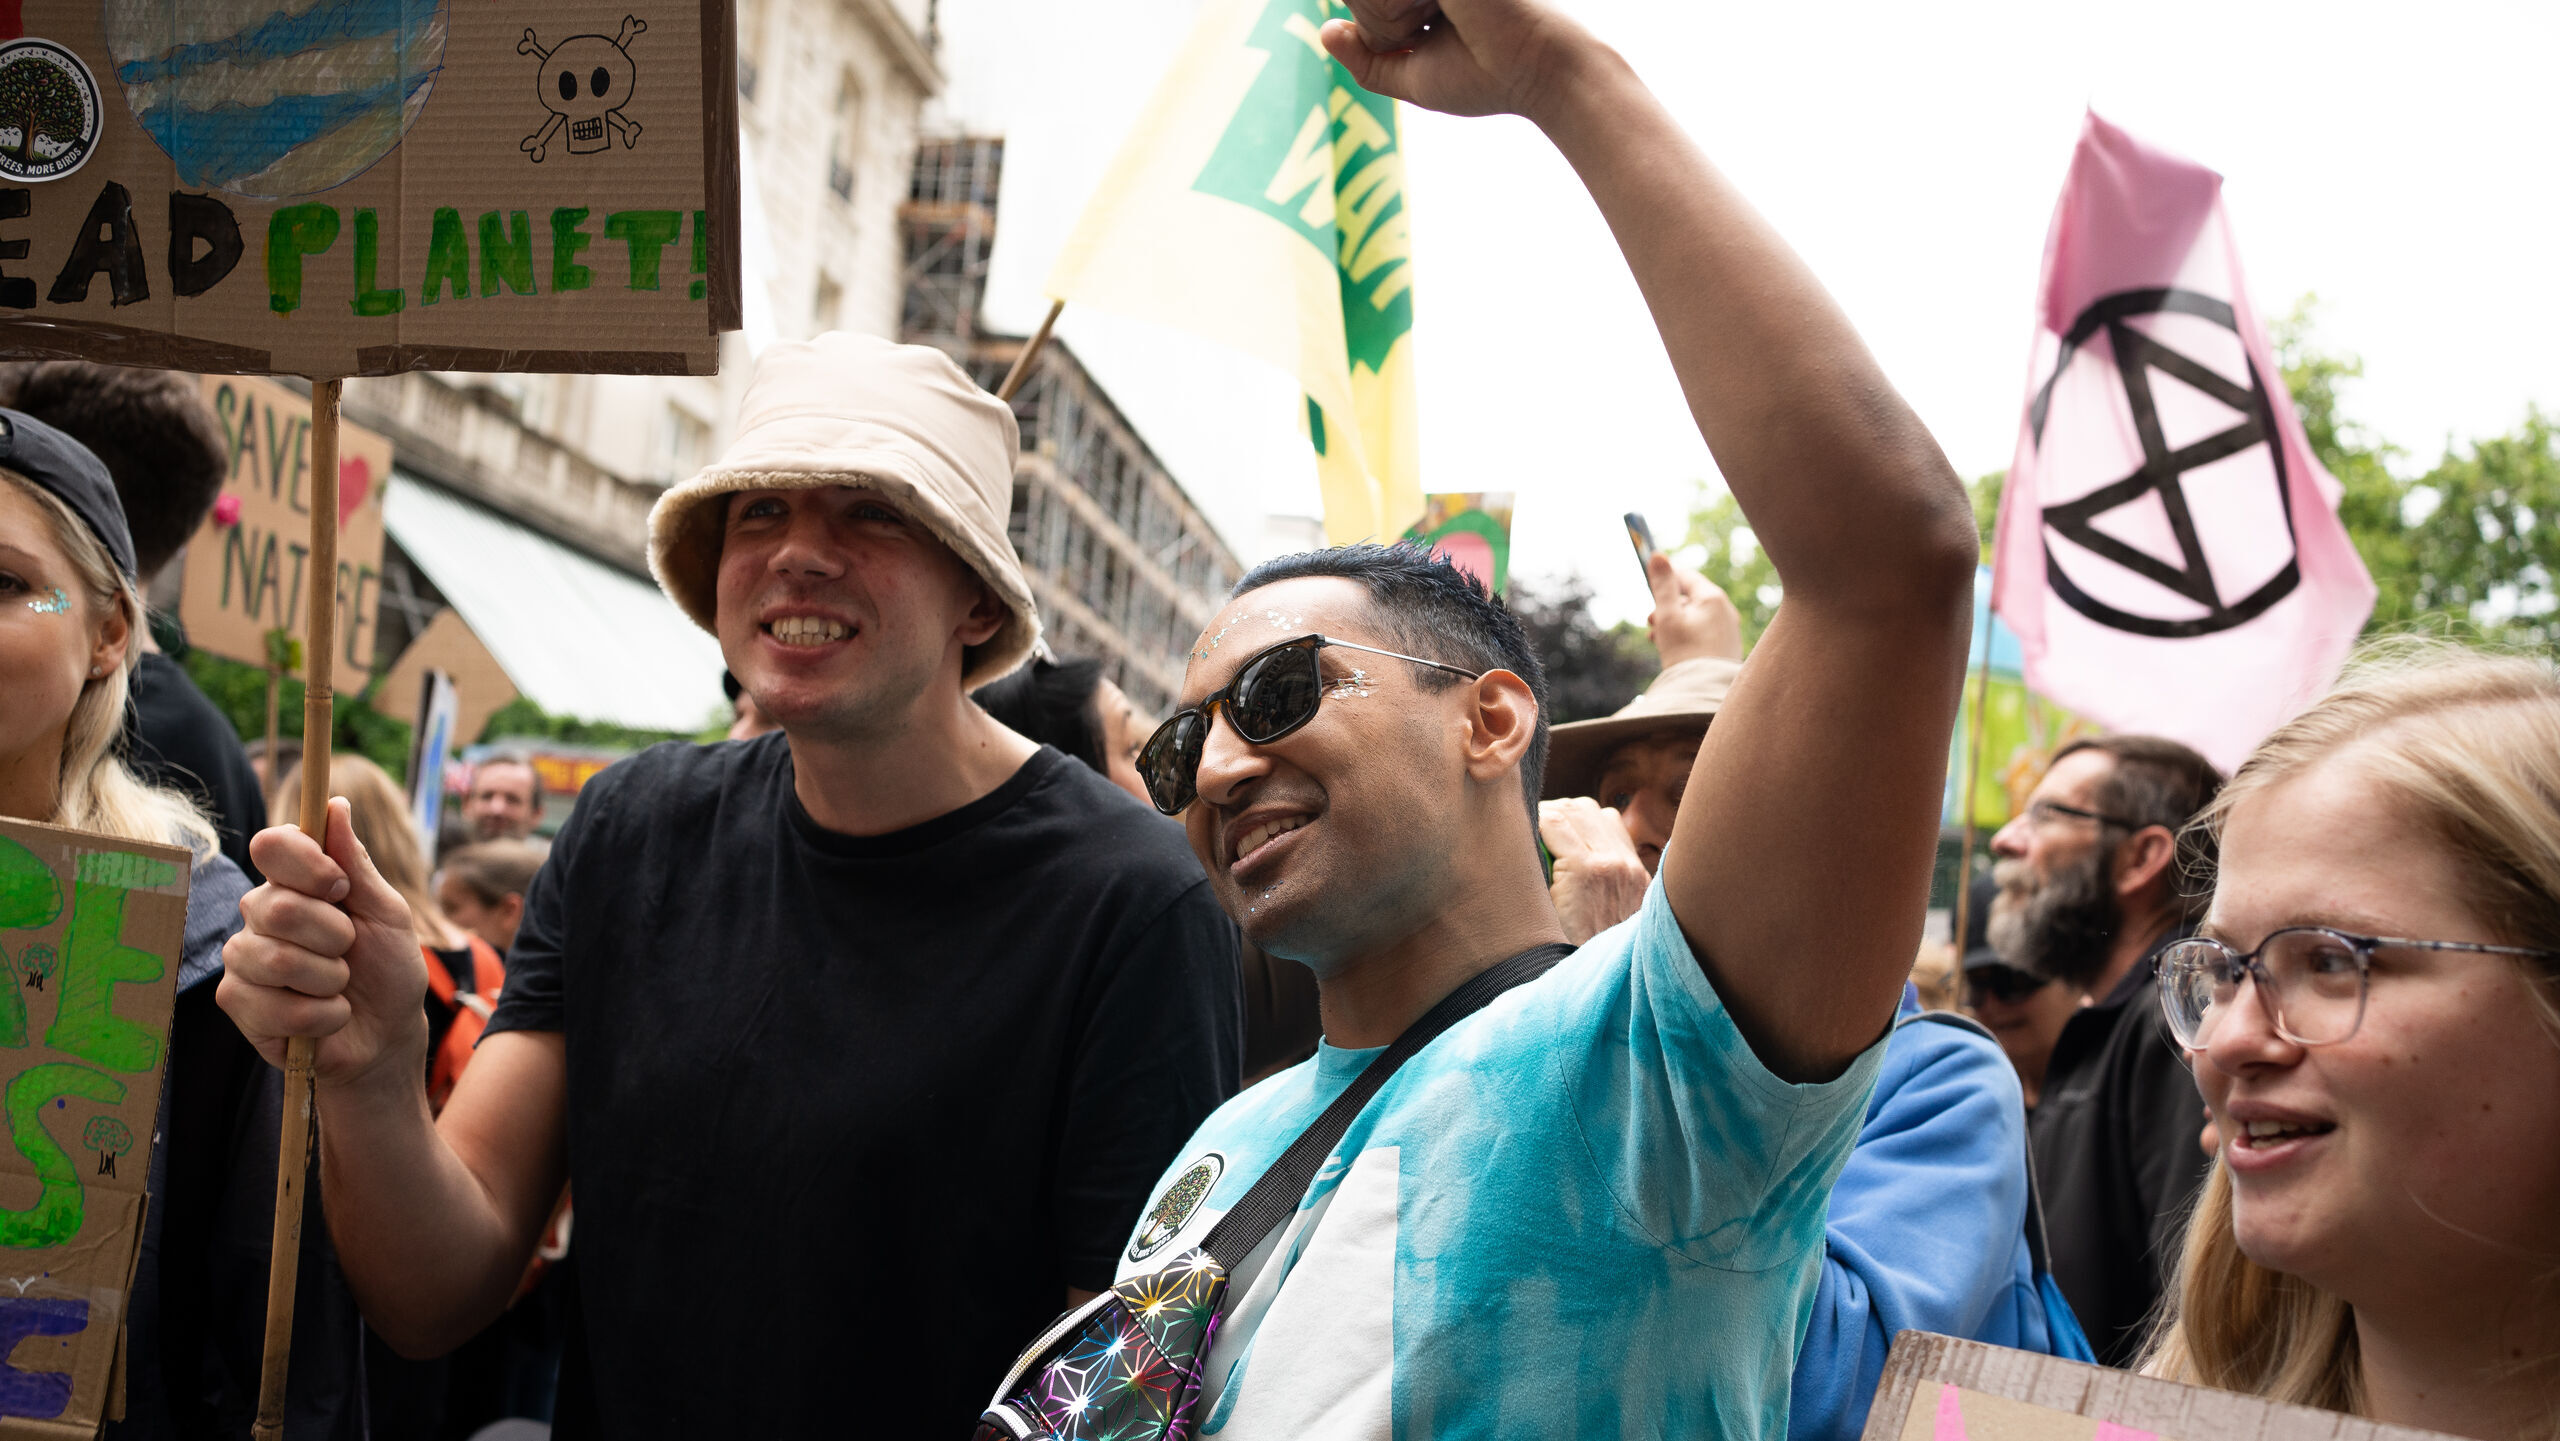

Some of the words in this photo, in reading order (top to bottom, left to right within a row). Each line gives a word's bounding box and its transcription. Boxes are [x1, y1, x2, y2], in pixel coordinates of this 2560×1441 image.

[0, 152, 24, 175] REES,
[26, 162, 56, 175] MORE
[56, 147, 82, 170] BIRDS
[263, 201, 706, 317] PLANET!
[216, 383, 312, 516] SAVE
[221, 522, 379, 672] NATRE
